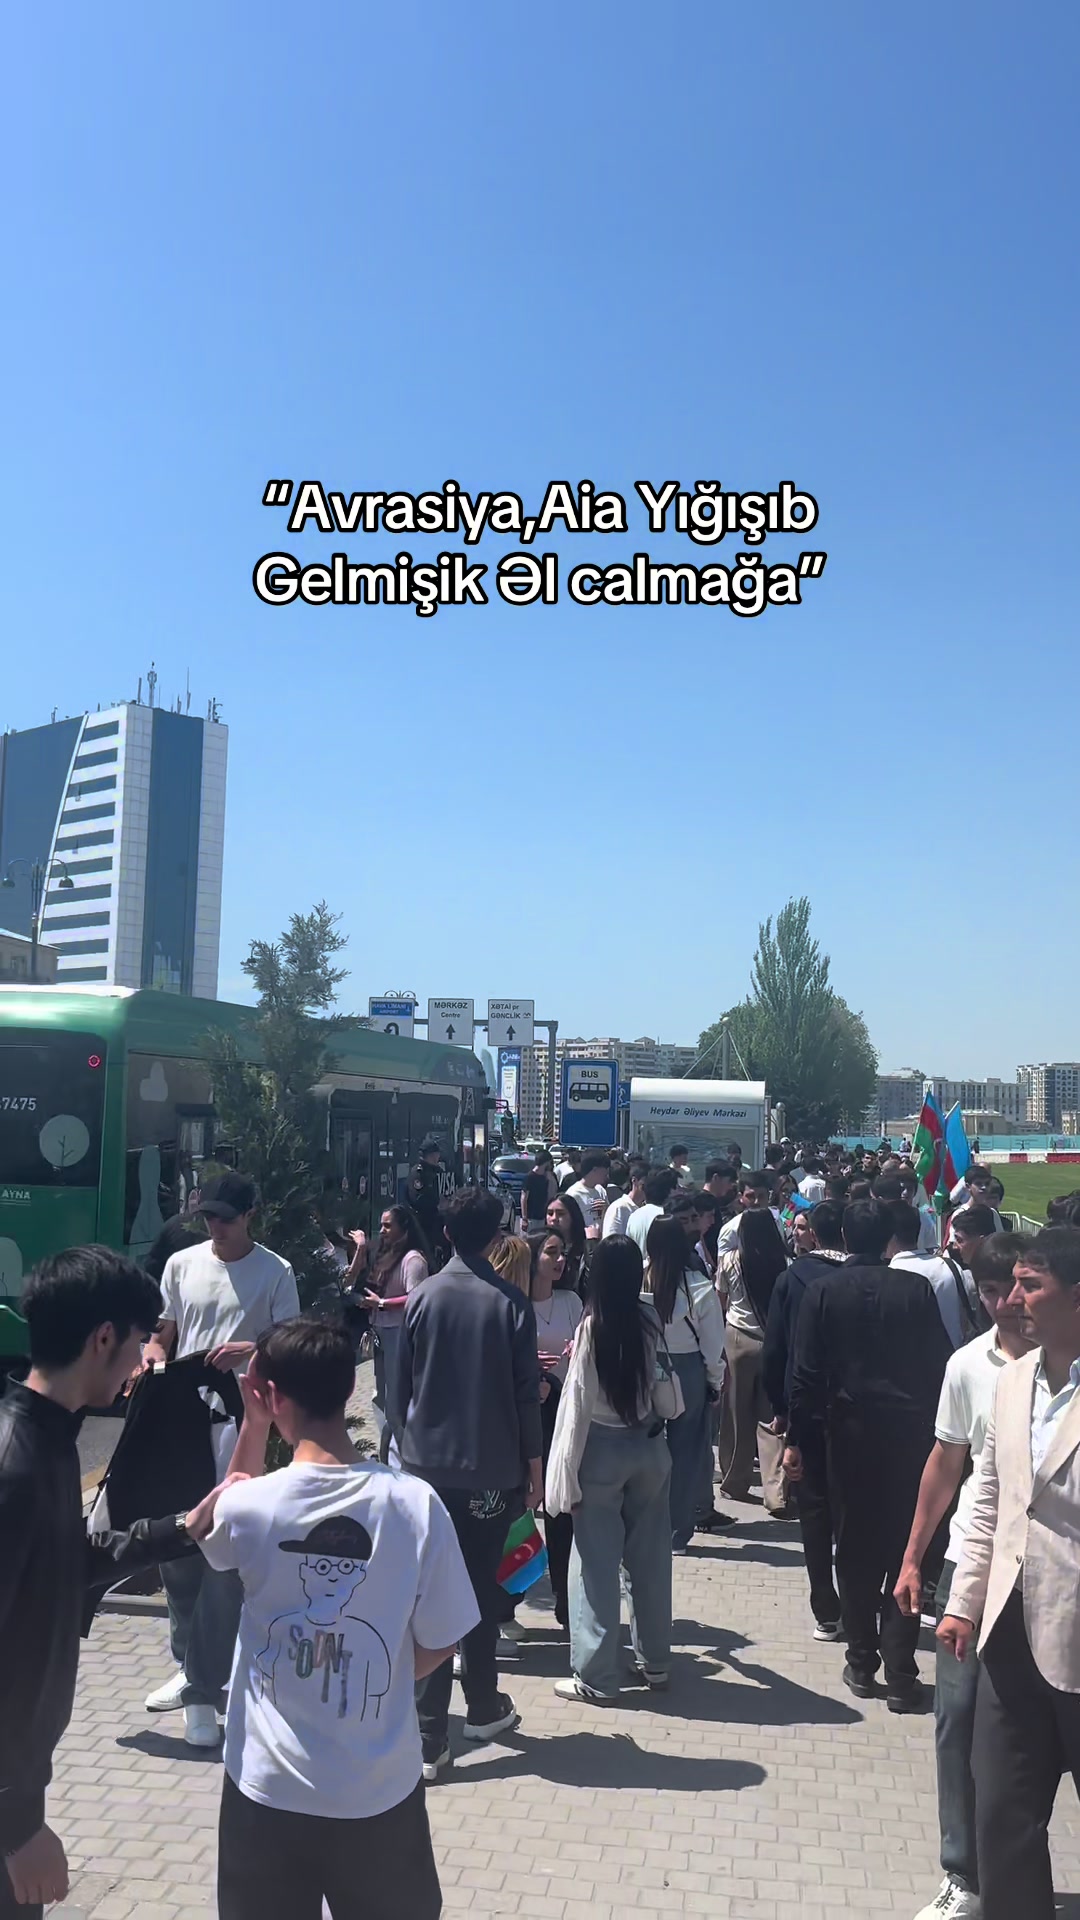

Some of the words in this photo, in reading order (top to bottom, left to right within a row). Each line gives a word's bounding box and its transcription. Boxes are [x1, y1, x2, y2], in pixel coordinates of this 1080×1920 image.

[581, 1070, 599, 1078] BUS
[0, 1097, 37, 1111] 7475
[683, 1107, 710, 1118] Əliyev
[437, 1172, 456, 1195] VISA
[1, 1189, 31, 1199] AYNA
